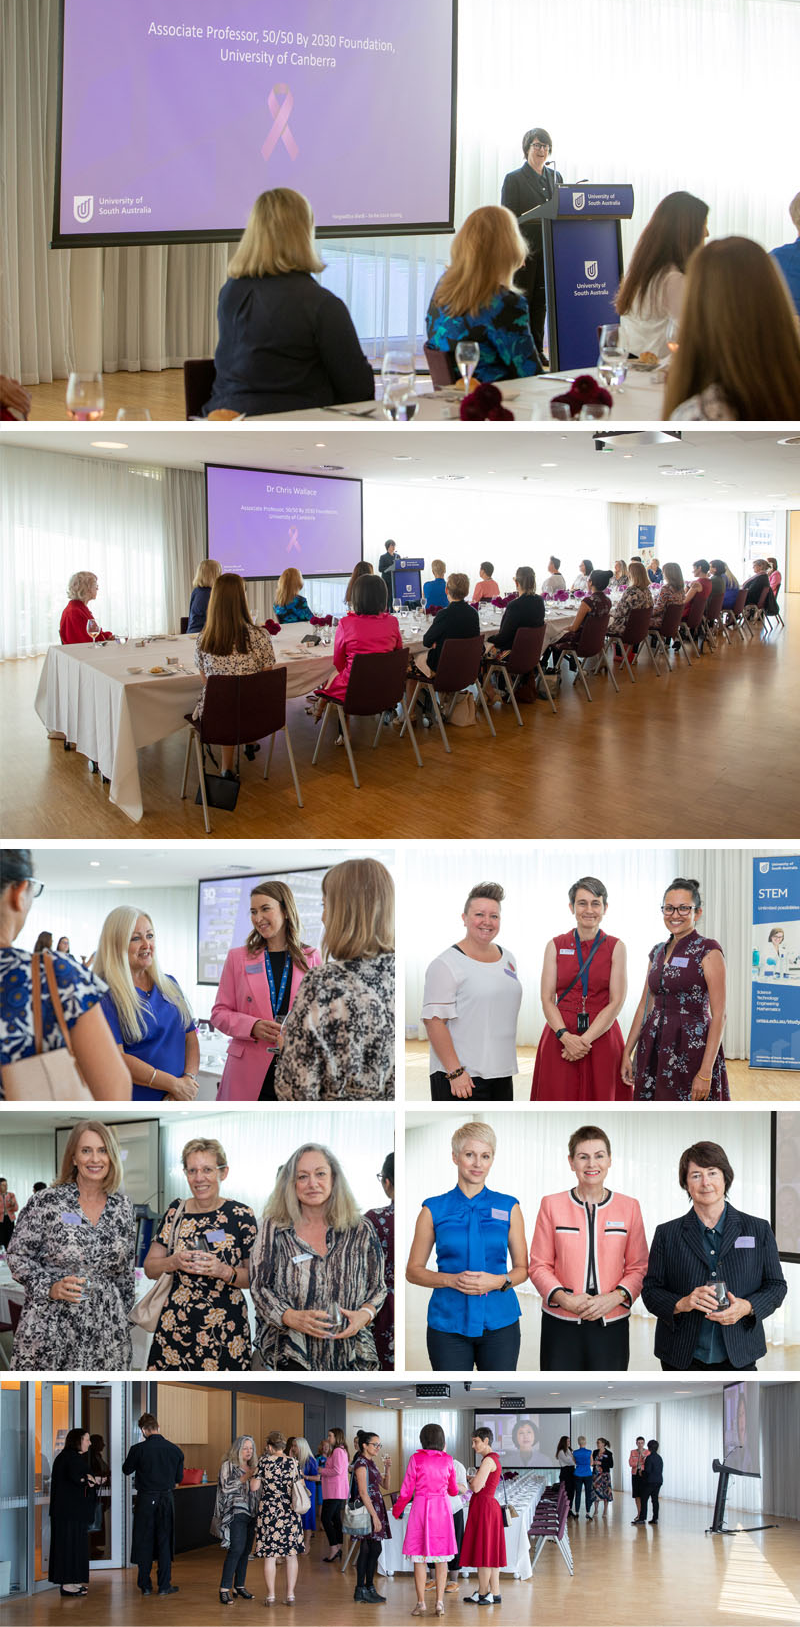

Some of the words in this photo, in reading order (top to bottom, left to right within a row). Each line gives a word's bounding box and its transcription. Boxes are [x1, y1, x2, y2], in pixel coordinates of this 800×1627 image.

[148, 22, 203, 37] Associate
[206, 25, 259, 44] Professor,
[262, 30, 293, 44] 50/50
[296, 33, 308, 48] By
[311, 34, 336, 47] 2030
[339, 36, 396, 54] Foundation,
[220, 48, 274, 67] University
[277, 52, 288, 64] of
[290, 53, 336, 67] Canberra
[99, 197, 134, 205] University
[276, 486, 292, 494] Chris
[293, 487, 317, 496] Wallace
[759, 889, 788, 898] STEM
